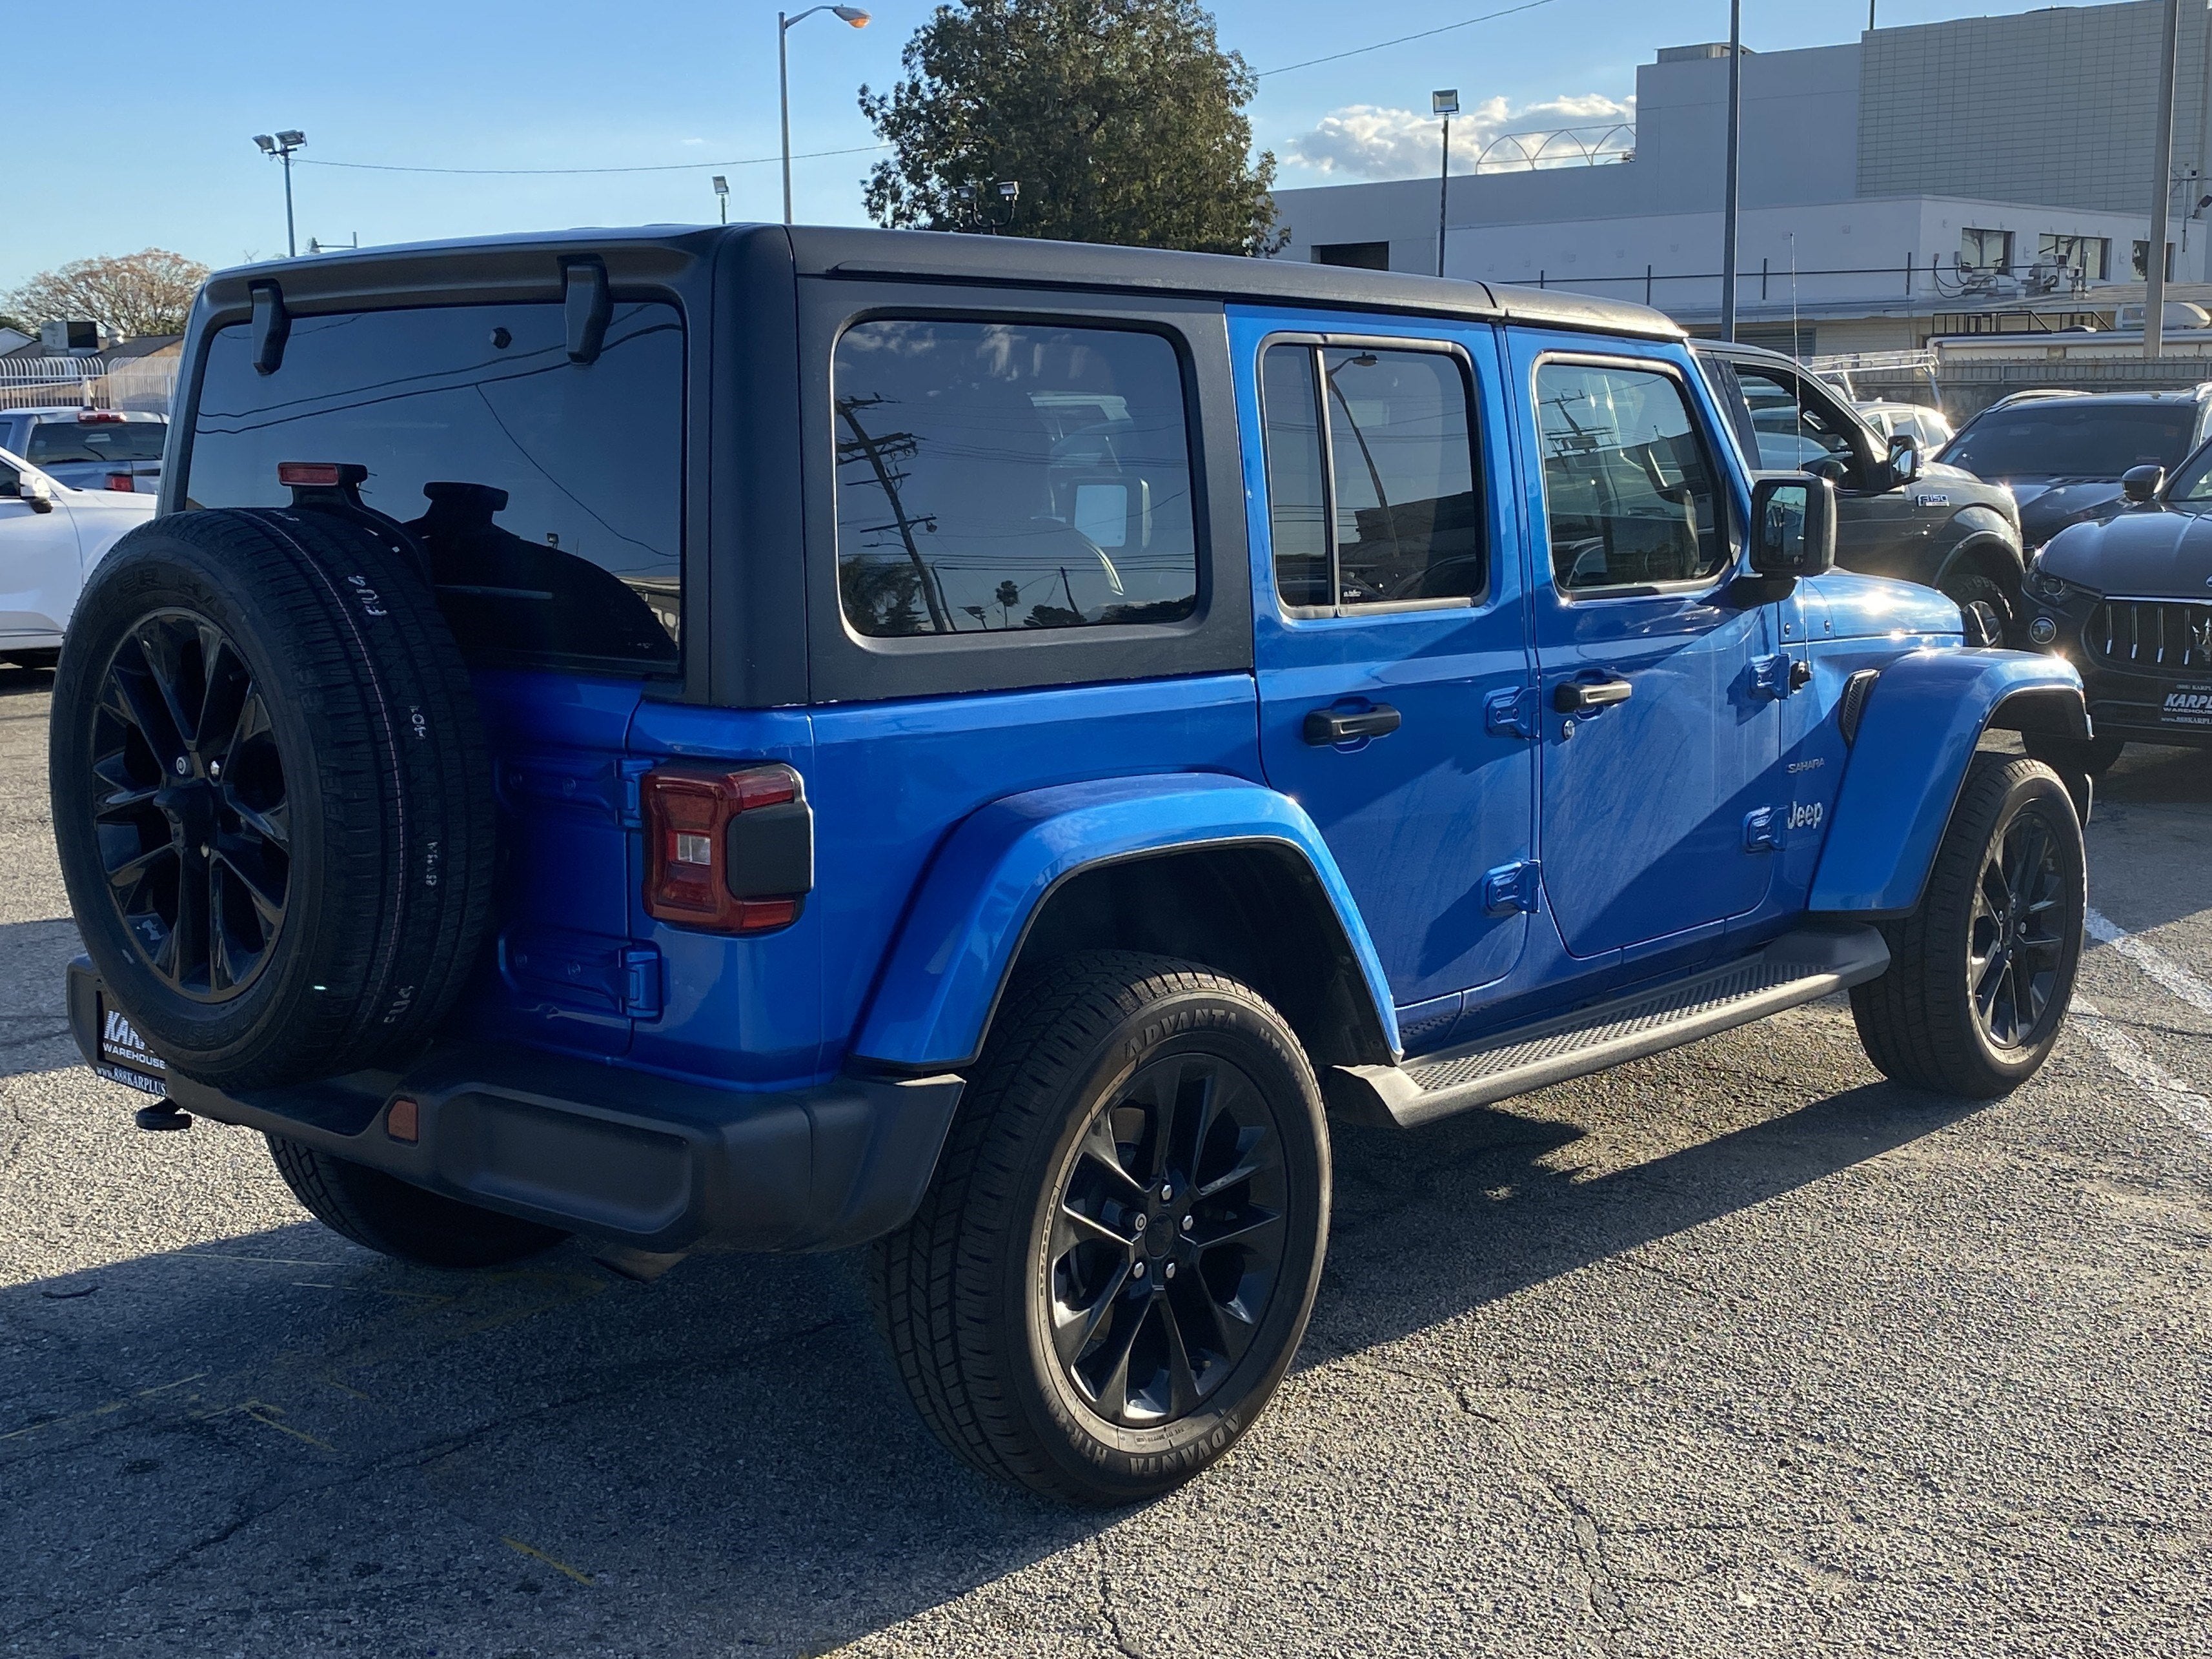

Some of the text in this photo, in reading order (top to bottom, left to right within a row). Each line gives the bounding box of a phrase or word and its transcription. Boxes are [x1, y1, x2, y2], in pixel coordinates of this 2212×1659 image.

[1787, 757, 1825, 773] SAHARA
[1787, 801, 1823, 829] Jeep
[1124, 1008, 1239, 1061] ADVANTA
[103, 1043, 166, 1070] WAREHOUSE
[1129, 1411, 1243, 1477] ADVANTA
